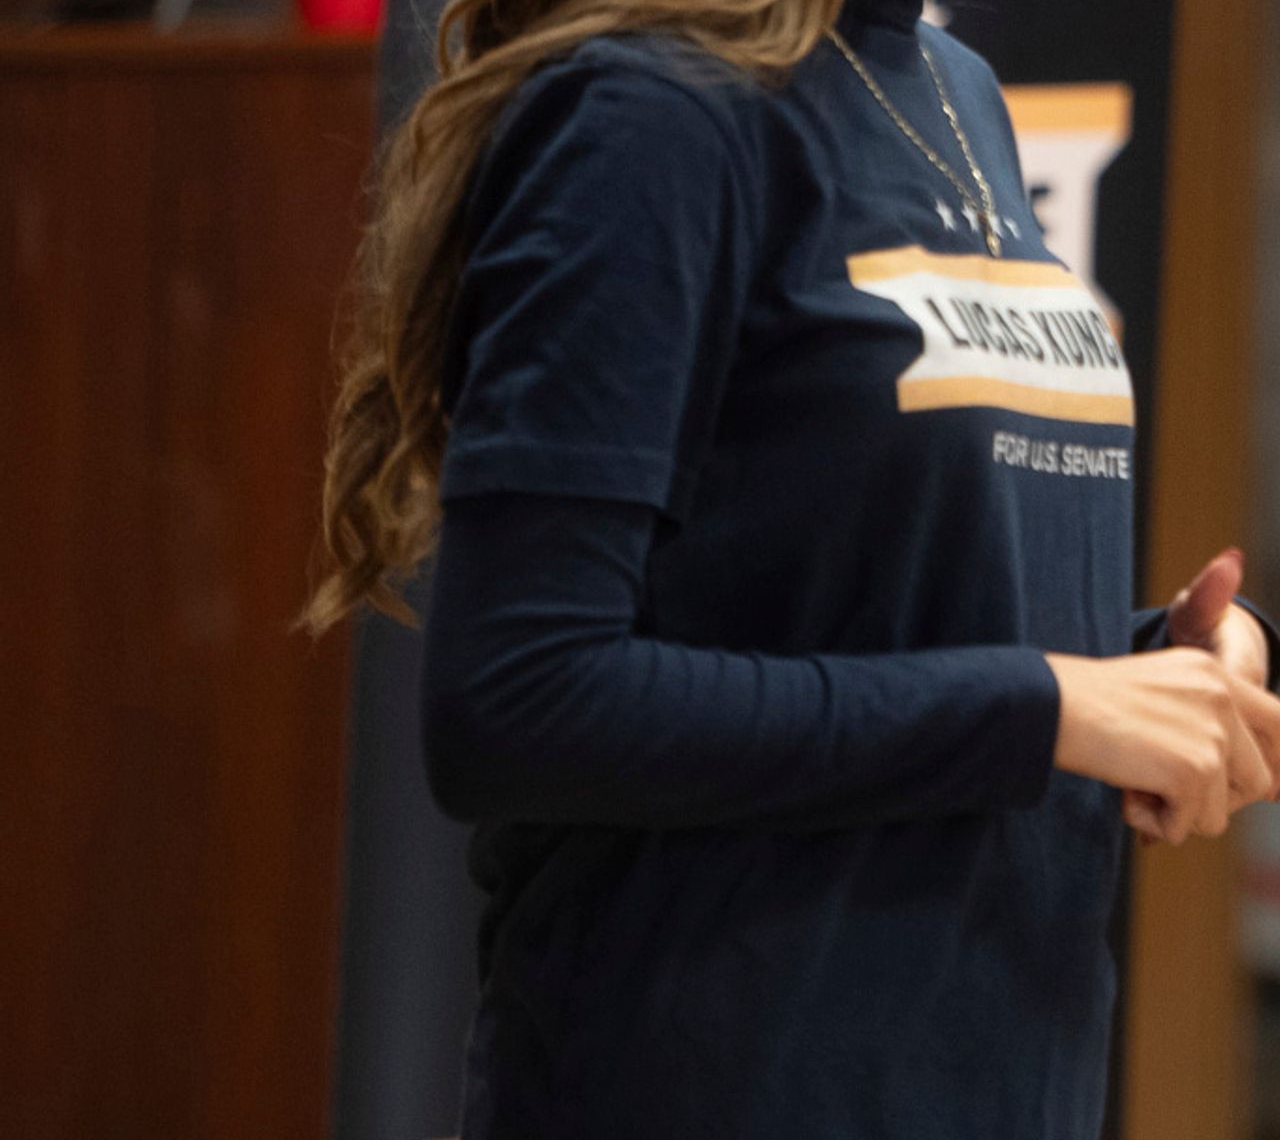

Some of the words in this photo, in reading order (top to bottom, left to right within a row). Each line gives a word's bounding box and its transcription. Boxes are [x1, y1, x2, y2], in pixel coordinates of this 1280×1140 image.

[925, 297, 1043, 363] LUCAS
[993, 430, 1029, 469] FOR
[1060, 443, 1129, 480] SENATE
